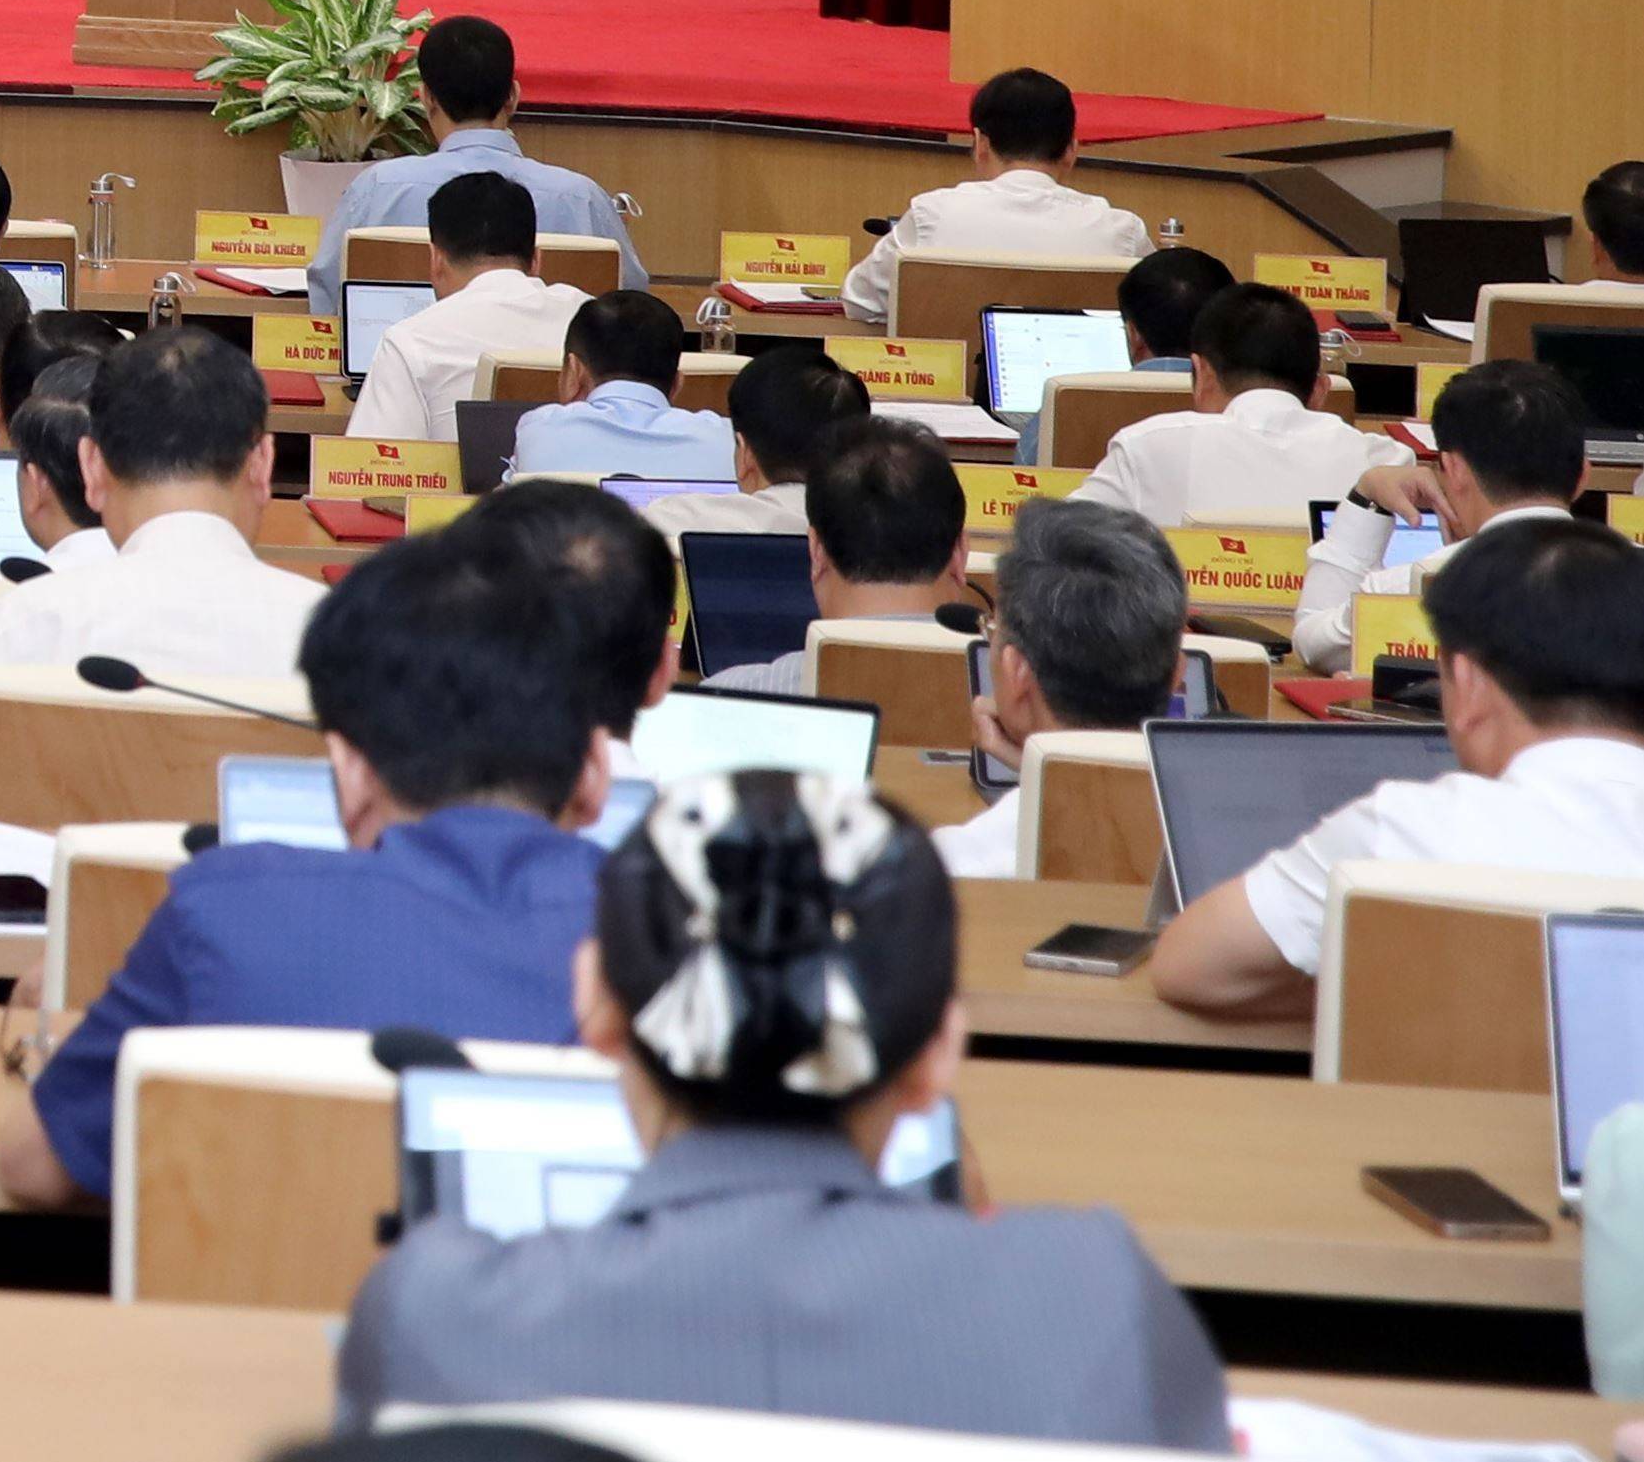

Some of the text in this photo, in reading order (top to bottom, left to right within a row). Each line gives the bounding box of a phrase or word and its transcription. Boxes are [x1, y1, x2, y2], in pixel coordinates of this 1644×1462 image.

[894, 373, 902, 385] A
[376, 473, 412, 488] TRUNG
[1223, 568, 1261, 589] QUỐC
[1266, 572, 1303, 593] LUẬN
